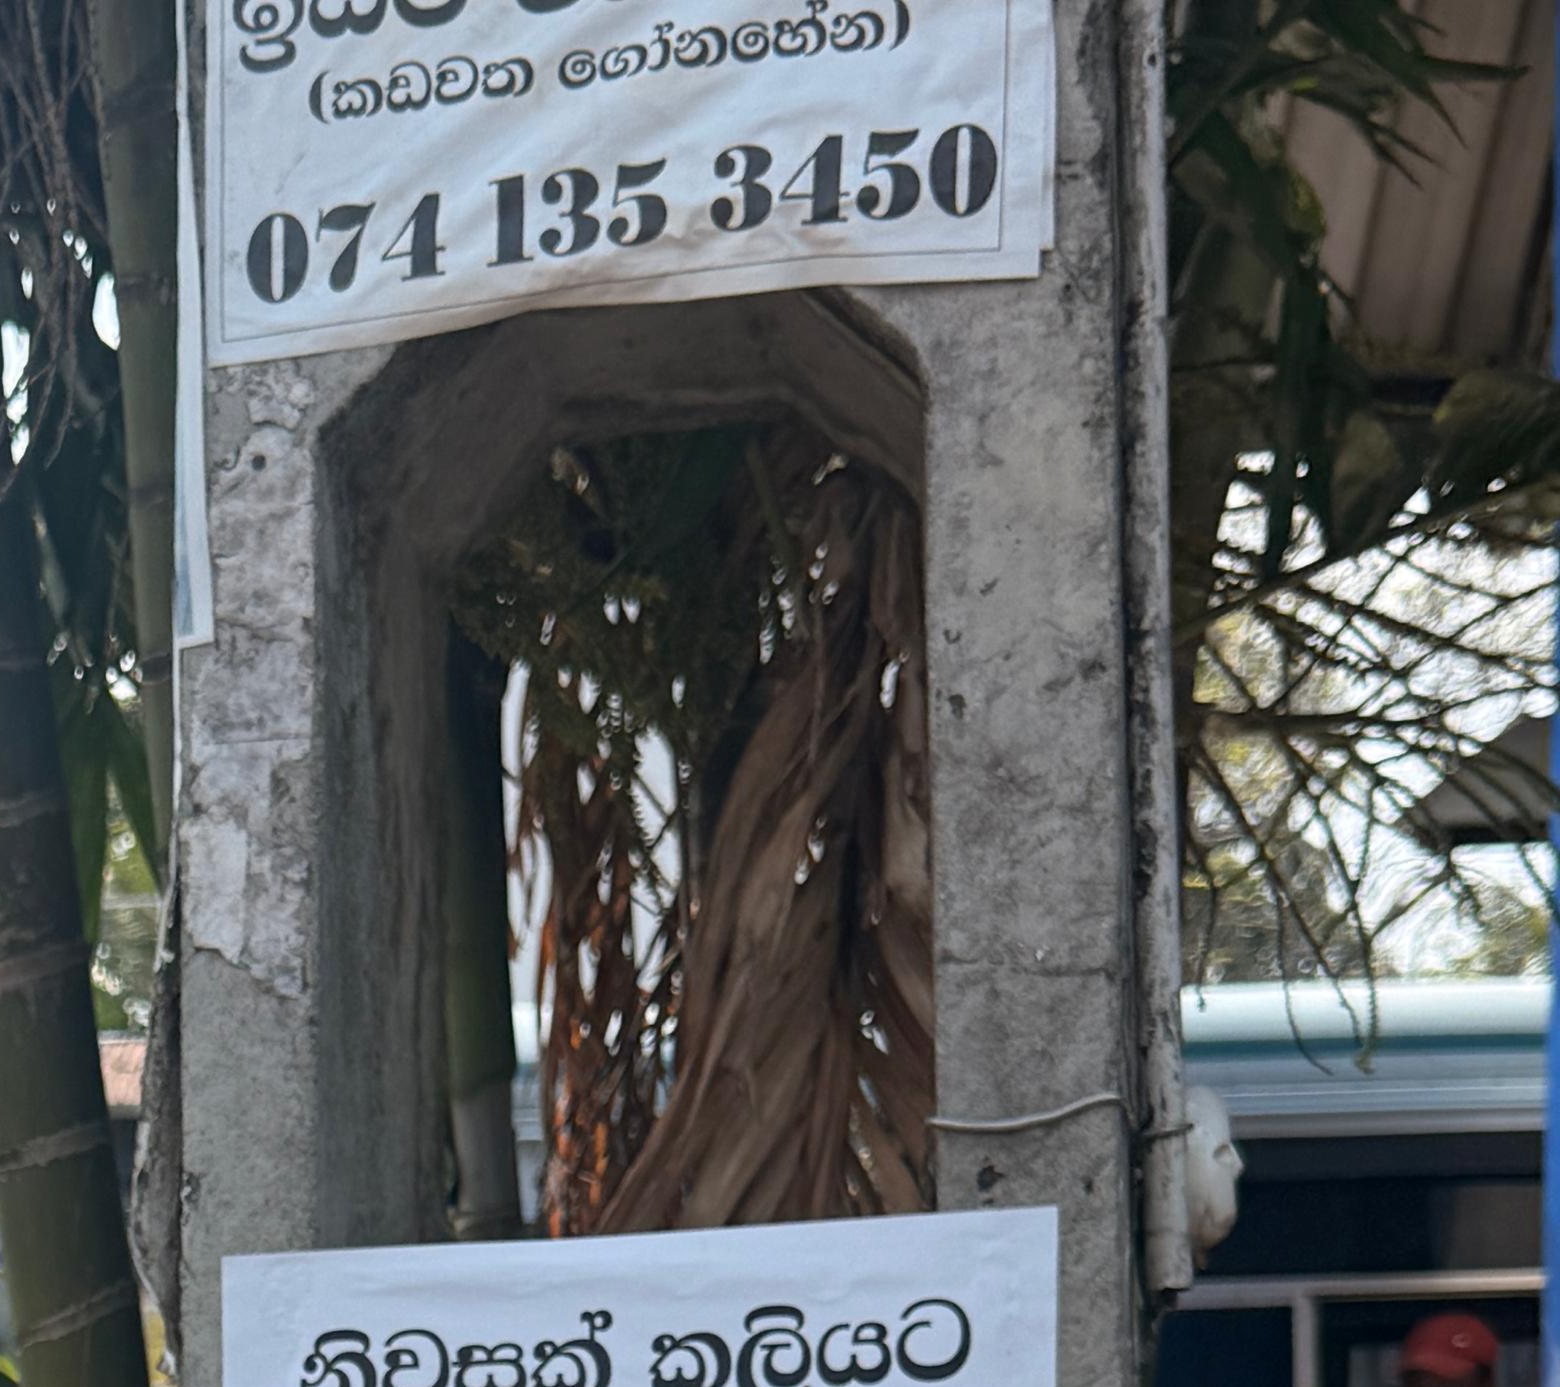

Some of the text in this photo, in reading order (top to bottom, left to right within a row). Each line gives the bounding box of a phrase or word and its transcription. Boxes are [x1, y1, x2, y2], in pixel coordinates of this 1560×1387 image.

[309, 56, 535, 125] (කඩවත
[246, 124, 998, 305] 074 135 3450
